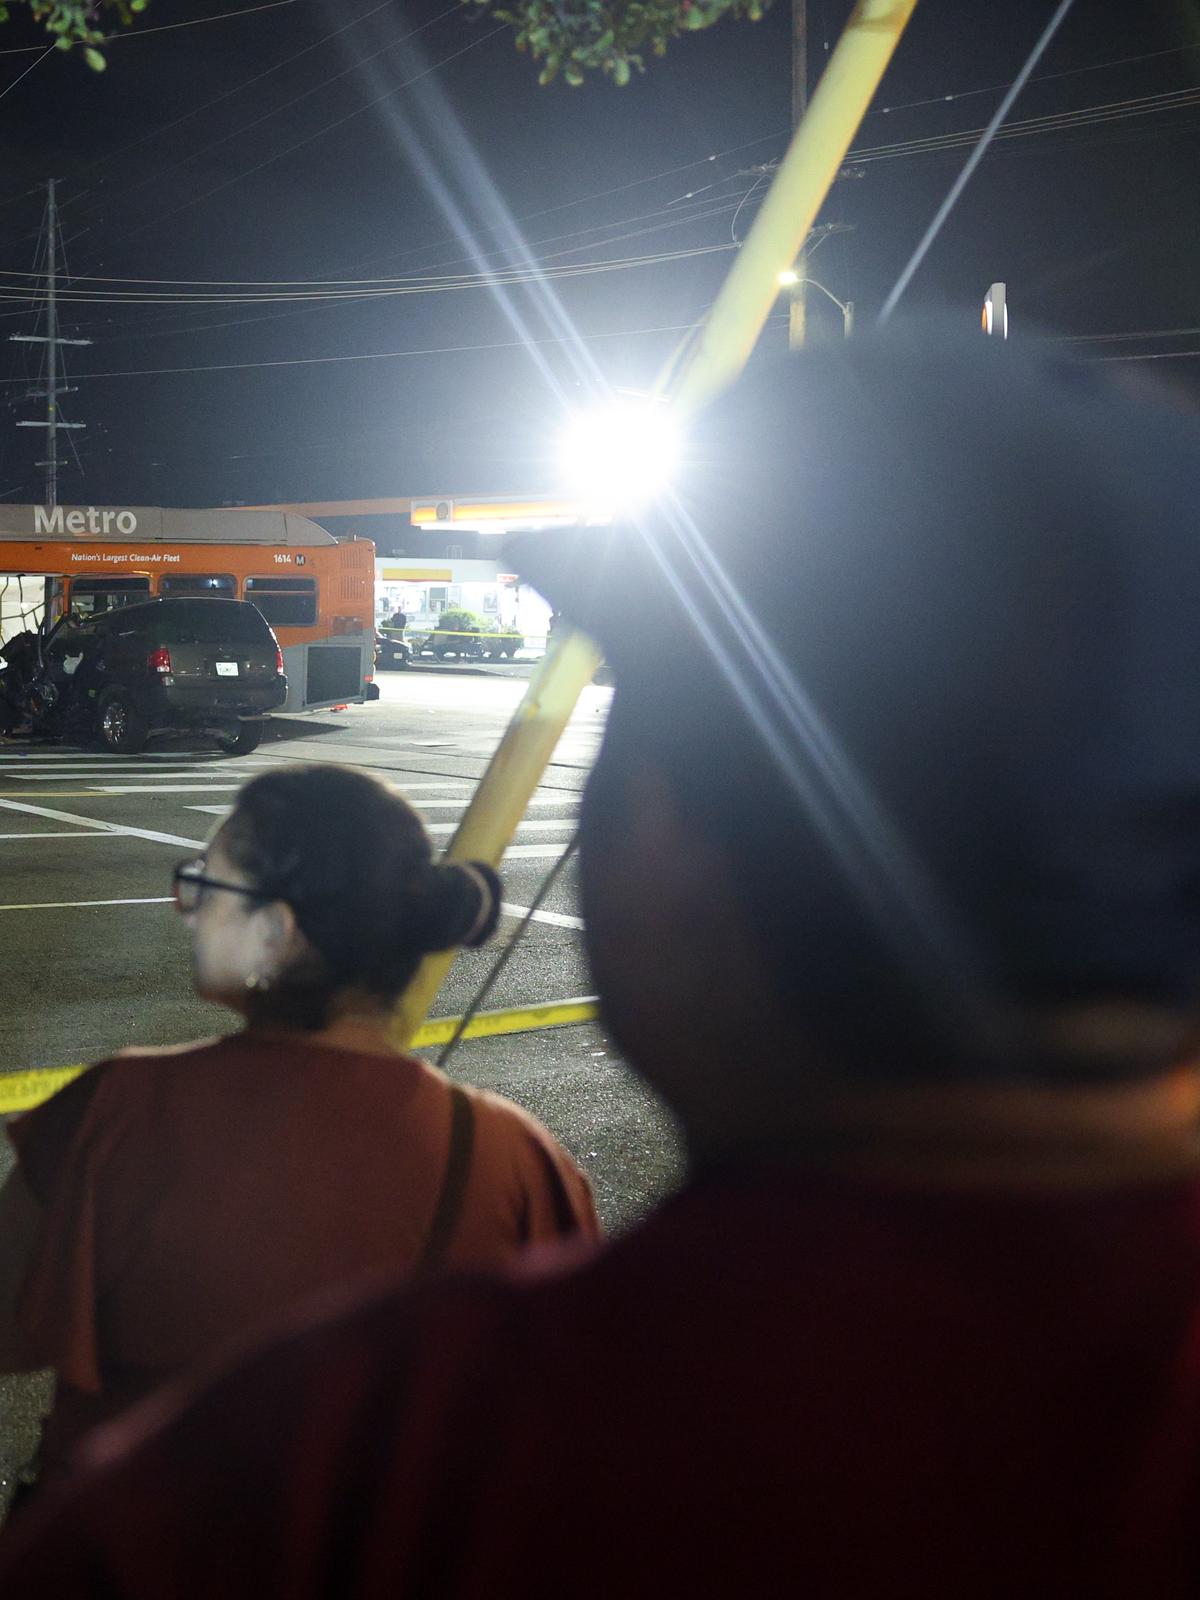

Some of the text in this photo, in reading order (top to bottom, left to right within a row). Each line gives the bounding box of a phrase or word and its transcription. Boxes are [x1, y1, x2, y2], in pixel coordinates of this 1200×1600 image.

[34, 506, 137, 534] Metro
[71, 553, 180, 564] Nation's Largest Clean-Air Fleet
[273, 554, 292, 563] 1614
